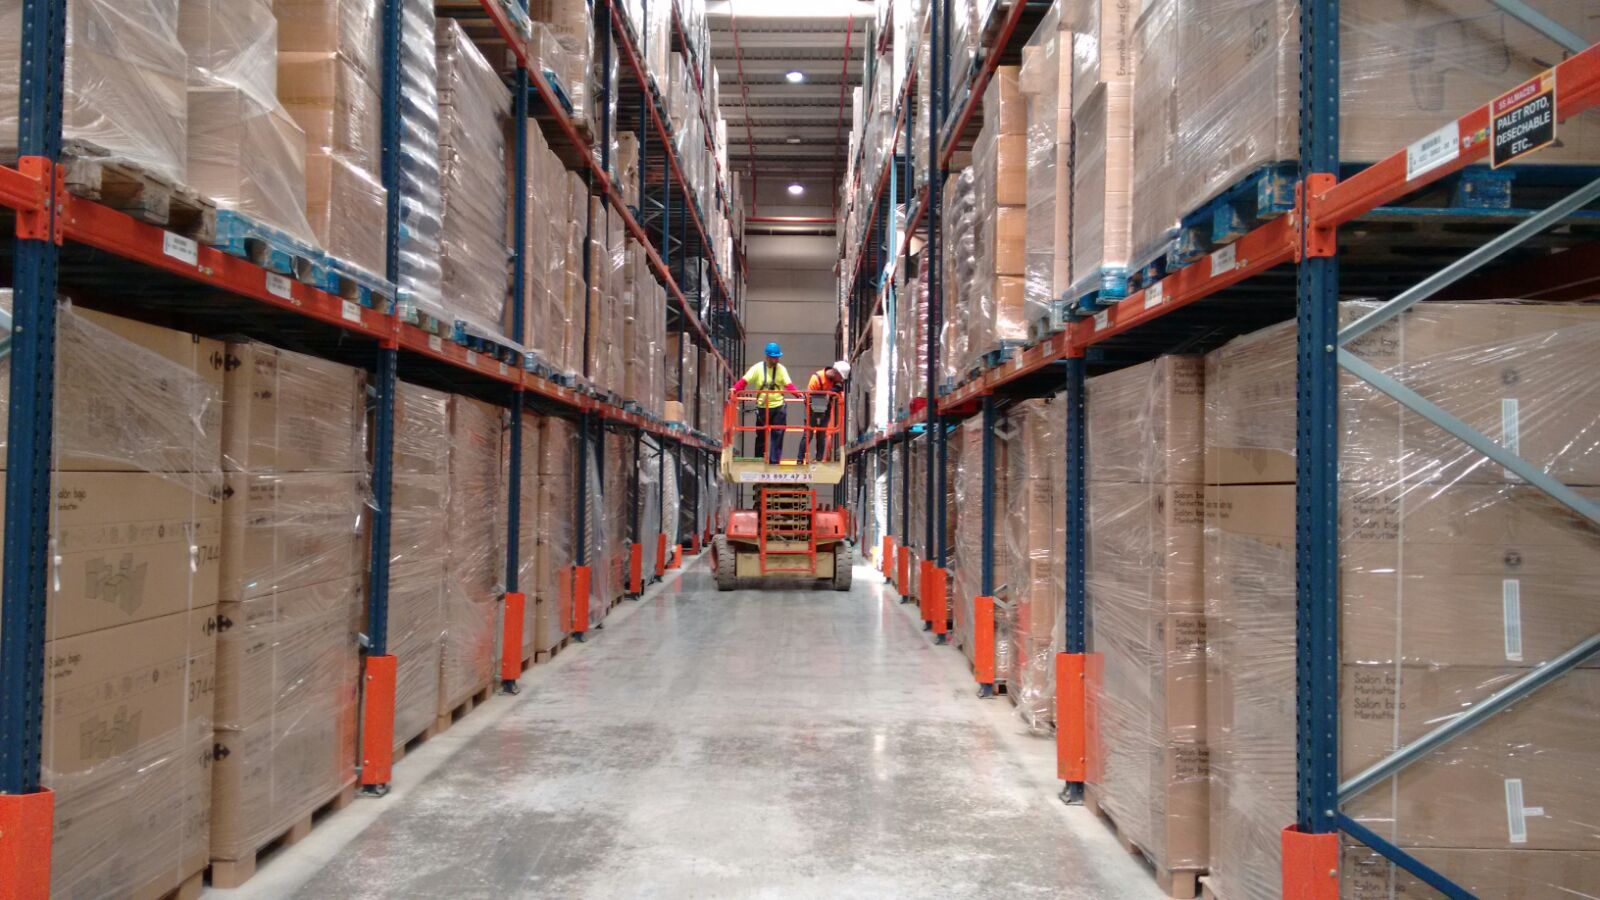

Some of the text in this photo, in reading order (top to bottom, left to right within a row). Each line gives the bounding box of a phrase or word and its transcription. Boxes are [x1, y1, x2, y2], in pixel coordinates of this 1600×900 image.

[1496, 110, 1551, 147] DESECHABLE
[1497, 96, 1549, 130] PALET ROTO,
